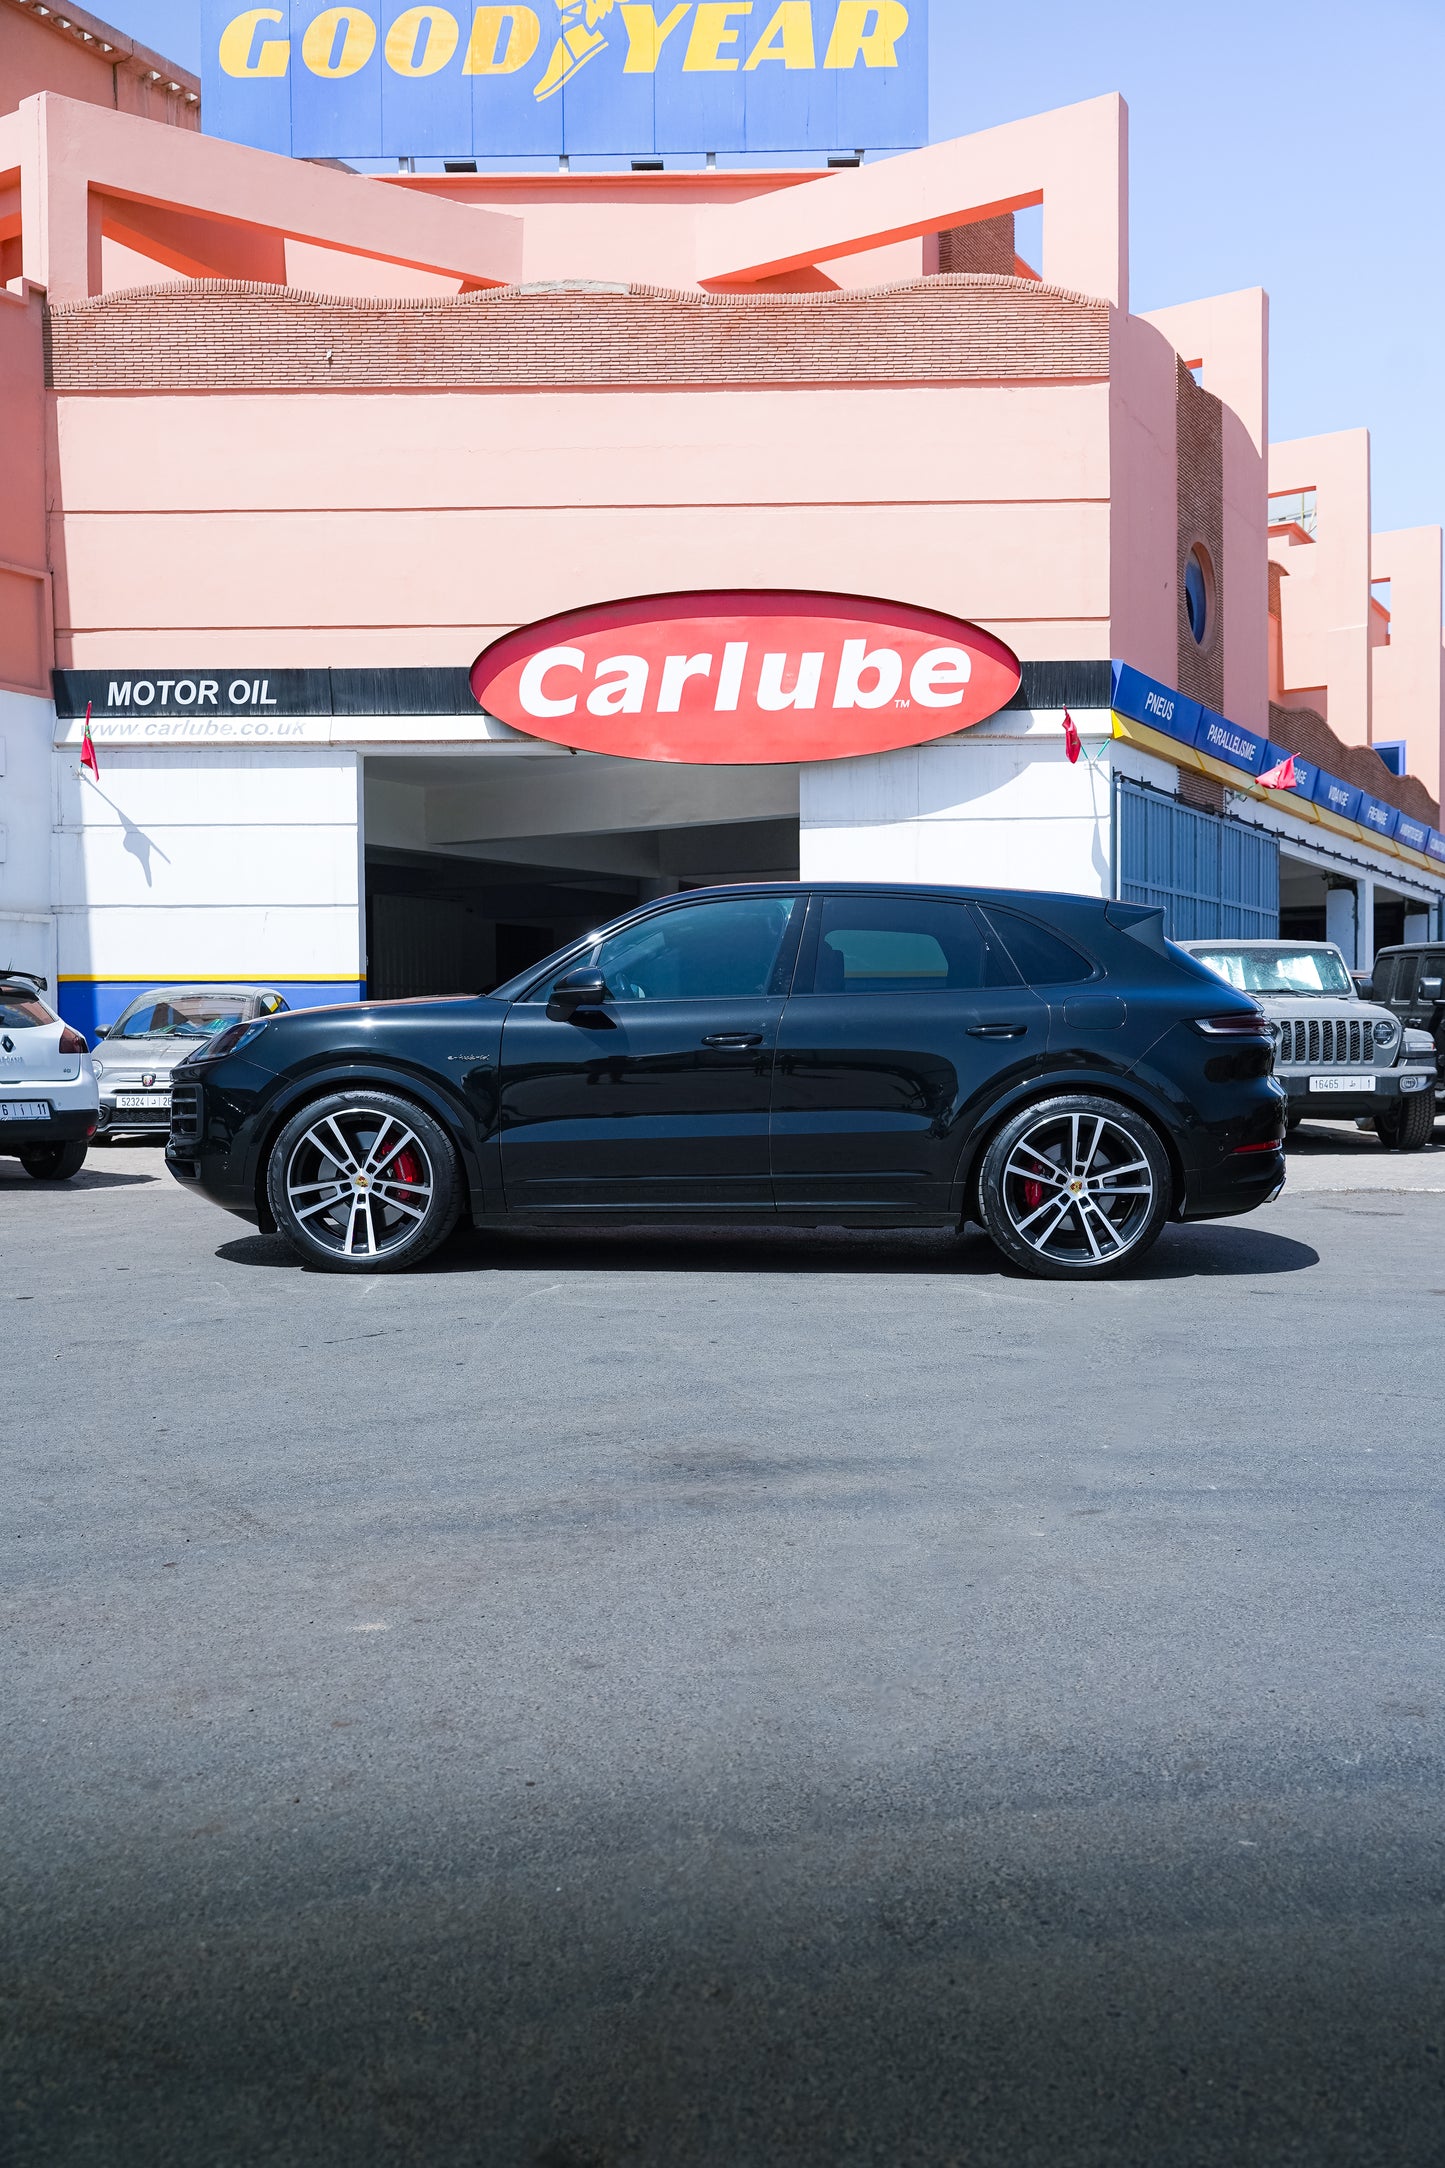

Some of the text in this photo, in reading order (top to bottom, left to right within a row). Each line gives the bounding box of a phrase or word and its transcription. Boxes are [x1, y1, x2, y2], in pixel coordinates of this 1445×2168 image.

[519, 639, 972, 718] Carlube
[107, 679, 278, 707] MOTOR OIL
[1144, 691, 1175, 721] PNEUS
[80, 719, 306, 736] www.carlube.co.uk
[1206, 723, 1257, 761] PARALLELISME
[1315, 1079, 1339, 1089] 16465
[37, 1103, 47, 1116] 11
[121, 1097, 145, 1107] 52324
